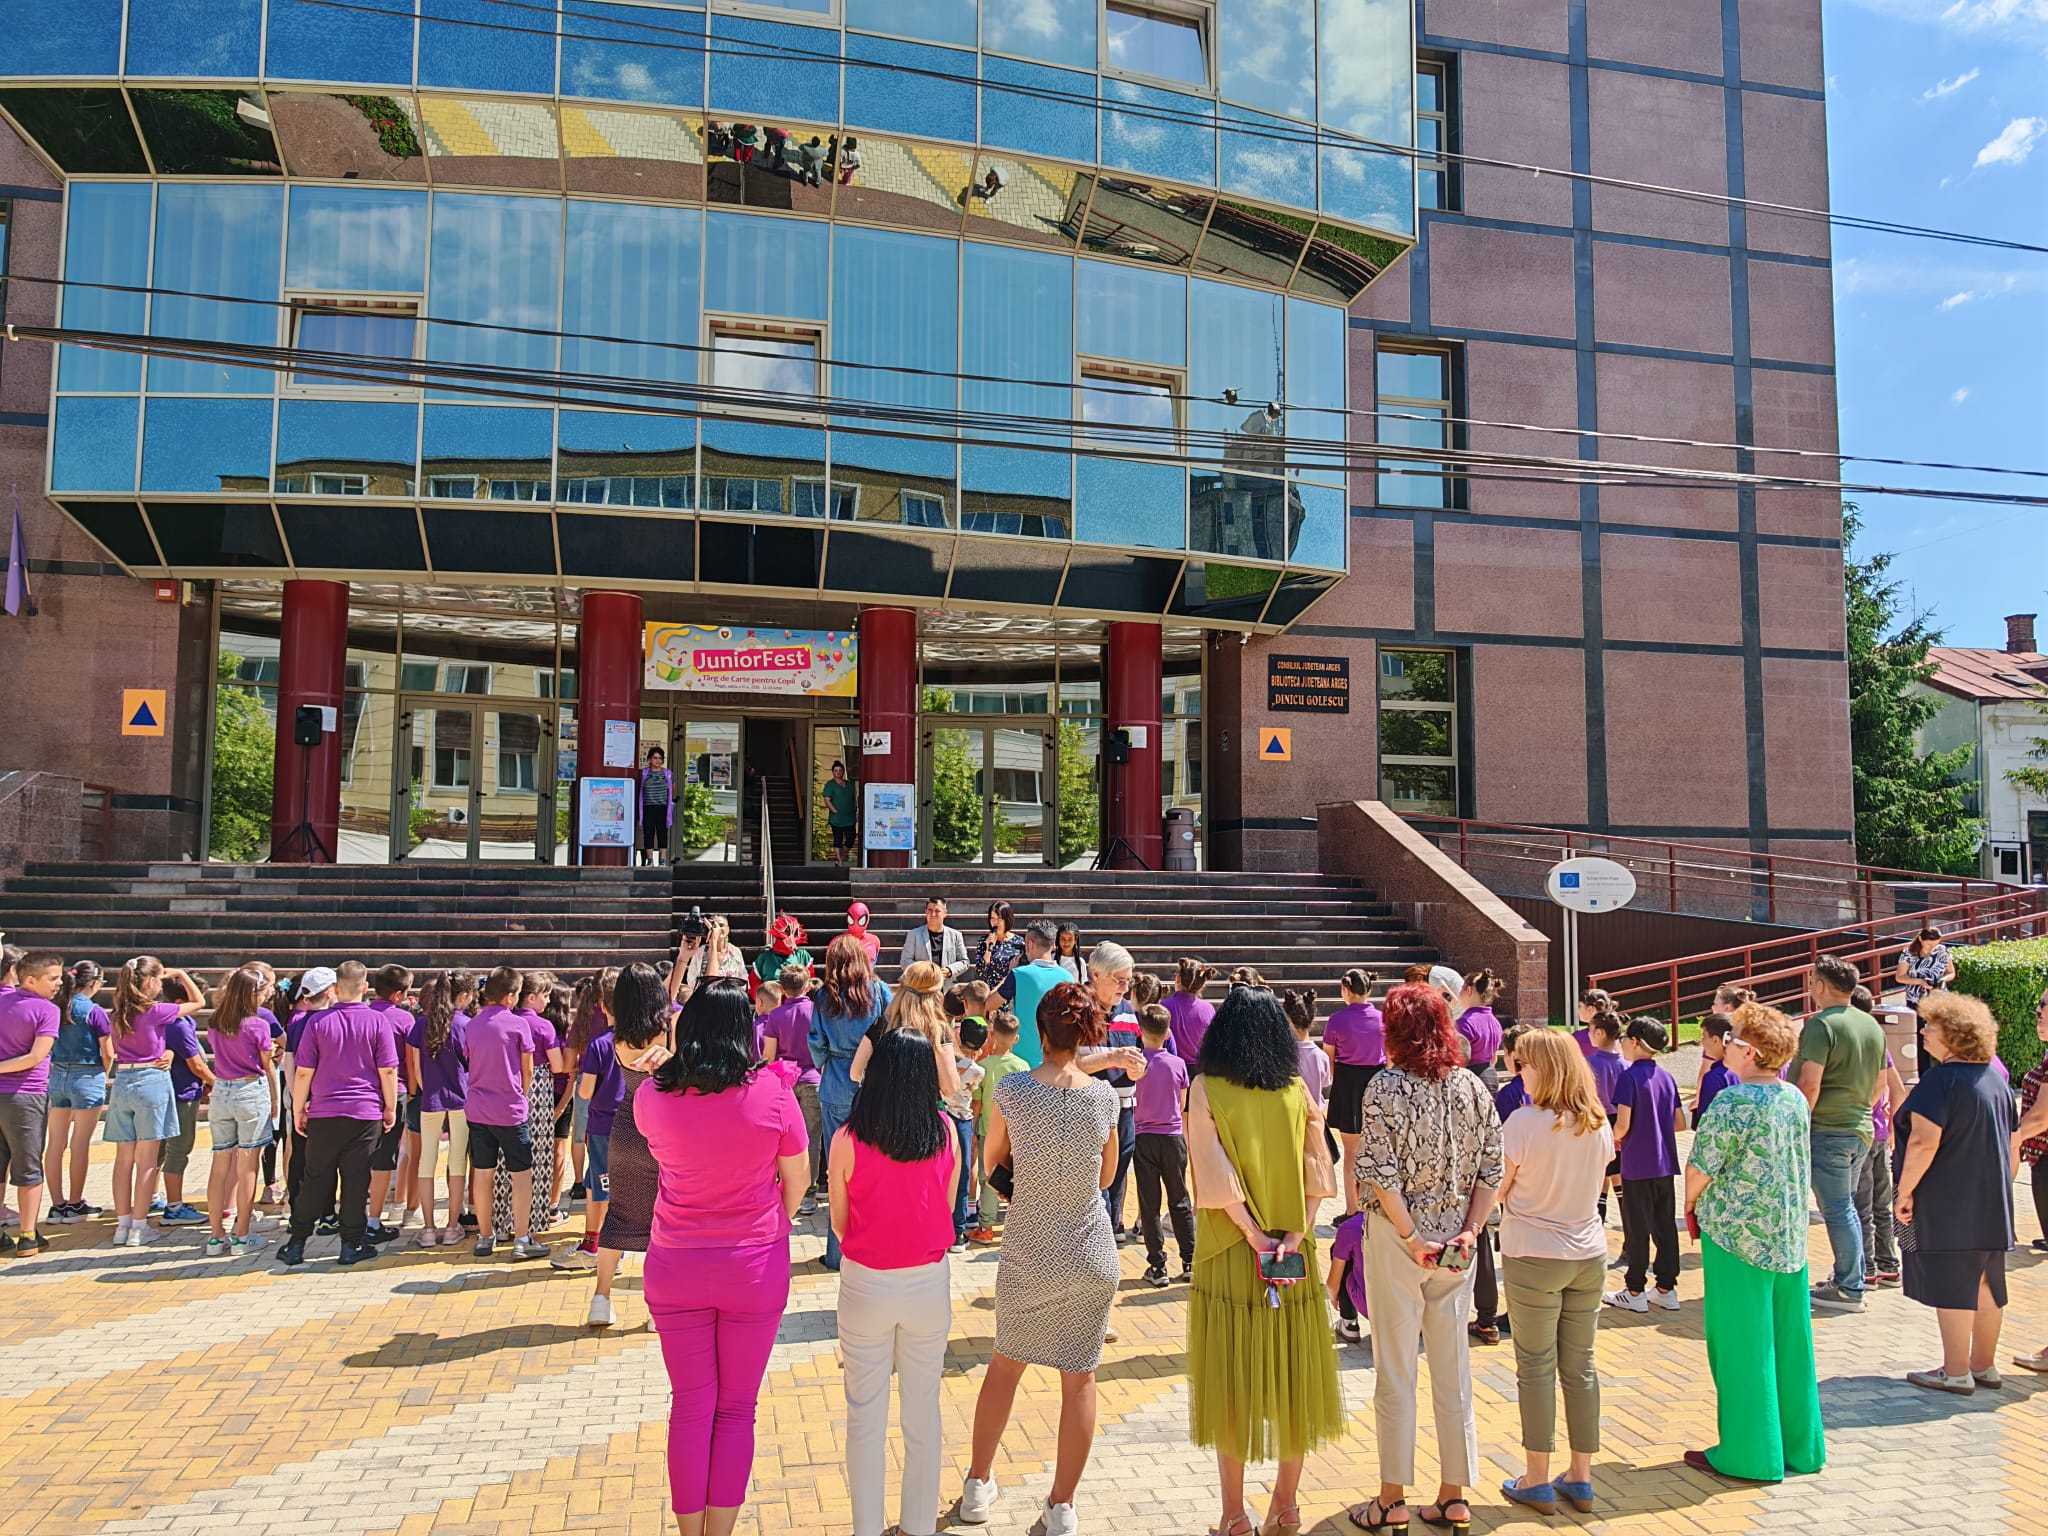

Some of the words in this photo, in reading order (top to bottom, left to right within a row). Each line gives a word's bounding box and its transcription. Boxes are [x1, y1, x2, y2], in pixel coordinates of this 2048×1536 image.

[698, 652, 805, 669] JuniorFest
[1278, 661, 1301, 670] CONSILIUL
[703, 674, 718, 683] Târg
[731, 675, 751, 683] Carte
[751, 677, 777, 685] pentru
[777, 677, 795, 686] Copii
[1271, 675, 1300, 687] BIBLIOTECA
